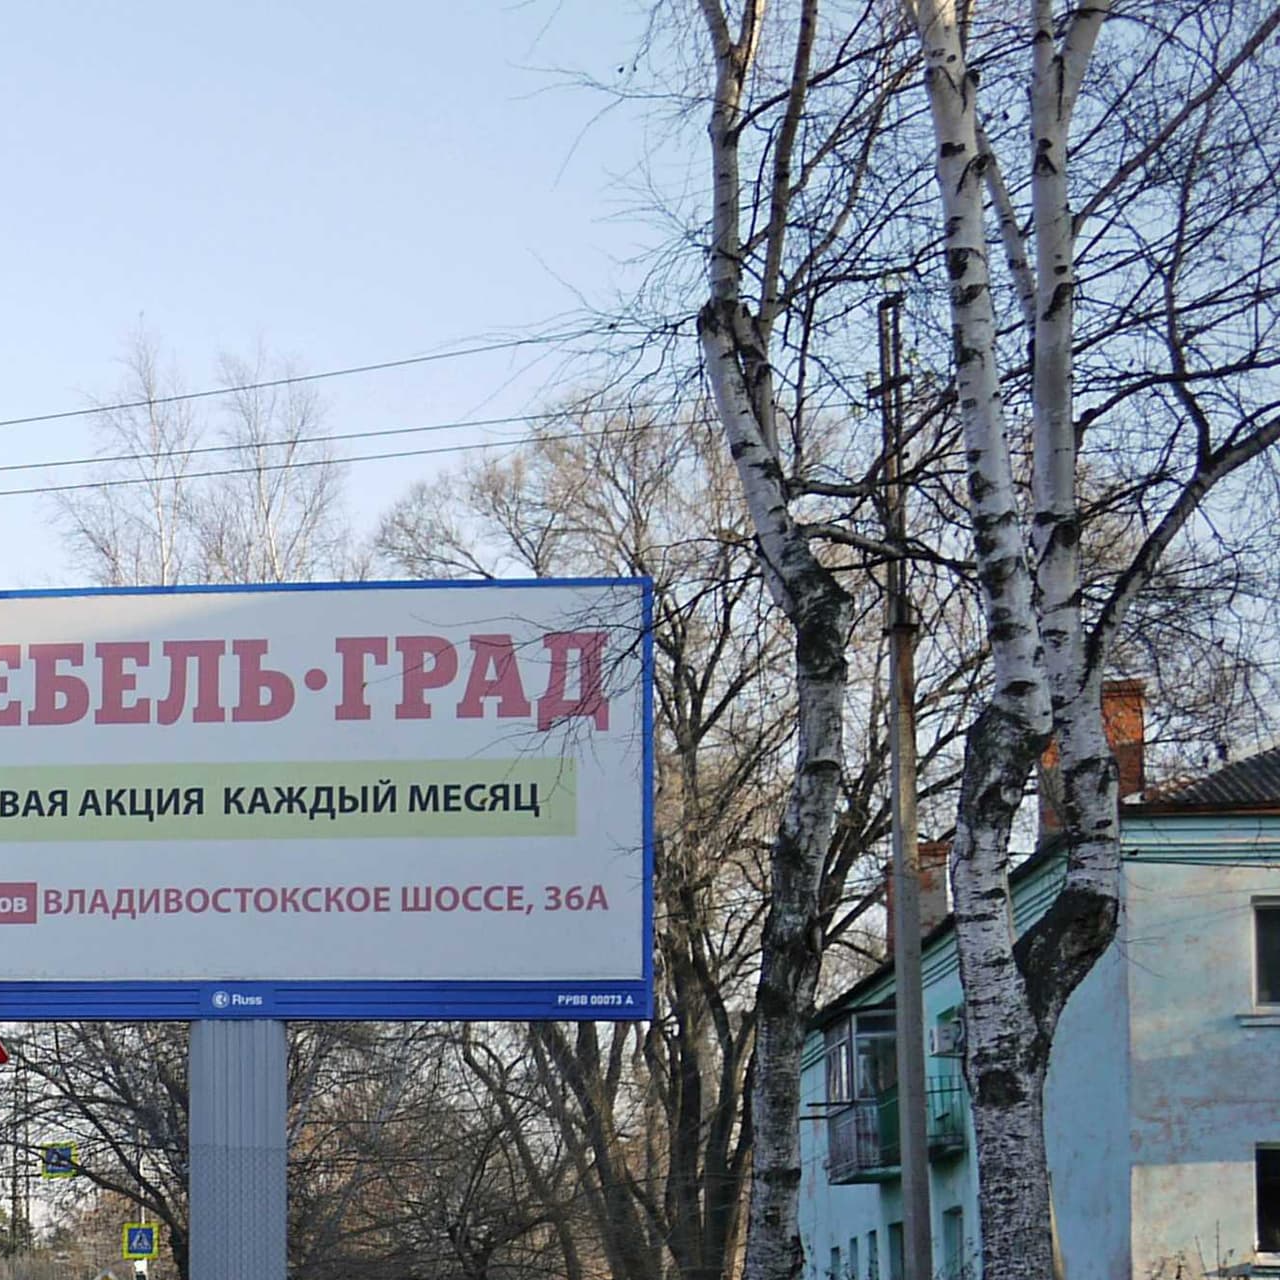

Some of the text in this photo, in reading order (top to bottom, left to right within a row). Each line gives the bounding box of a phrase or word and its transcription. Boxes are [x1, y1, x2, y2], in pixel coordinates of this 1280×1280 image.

[78, 787, 204, 822] АКЦИЯ
[224, 779, 397, 820] КАЖДЫЙ
[408, 783, 540, 817] МЕСЯЦ
[43, 885, 609, 919] ВЛАДИВОСТОКСКОЕ ШОССЕ, 36А
[232, 994, 262, 1006] Russ
